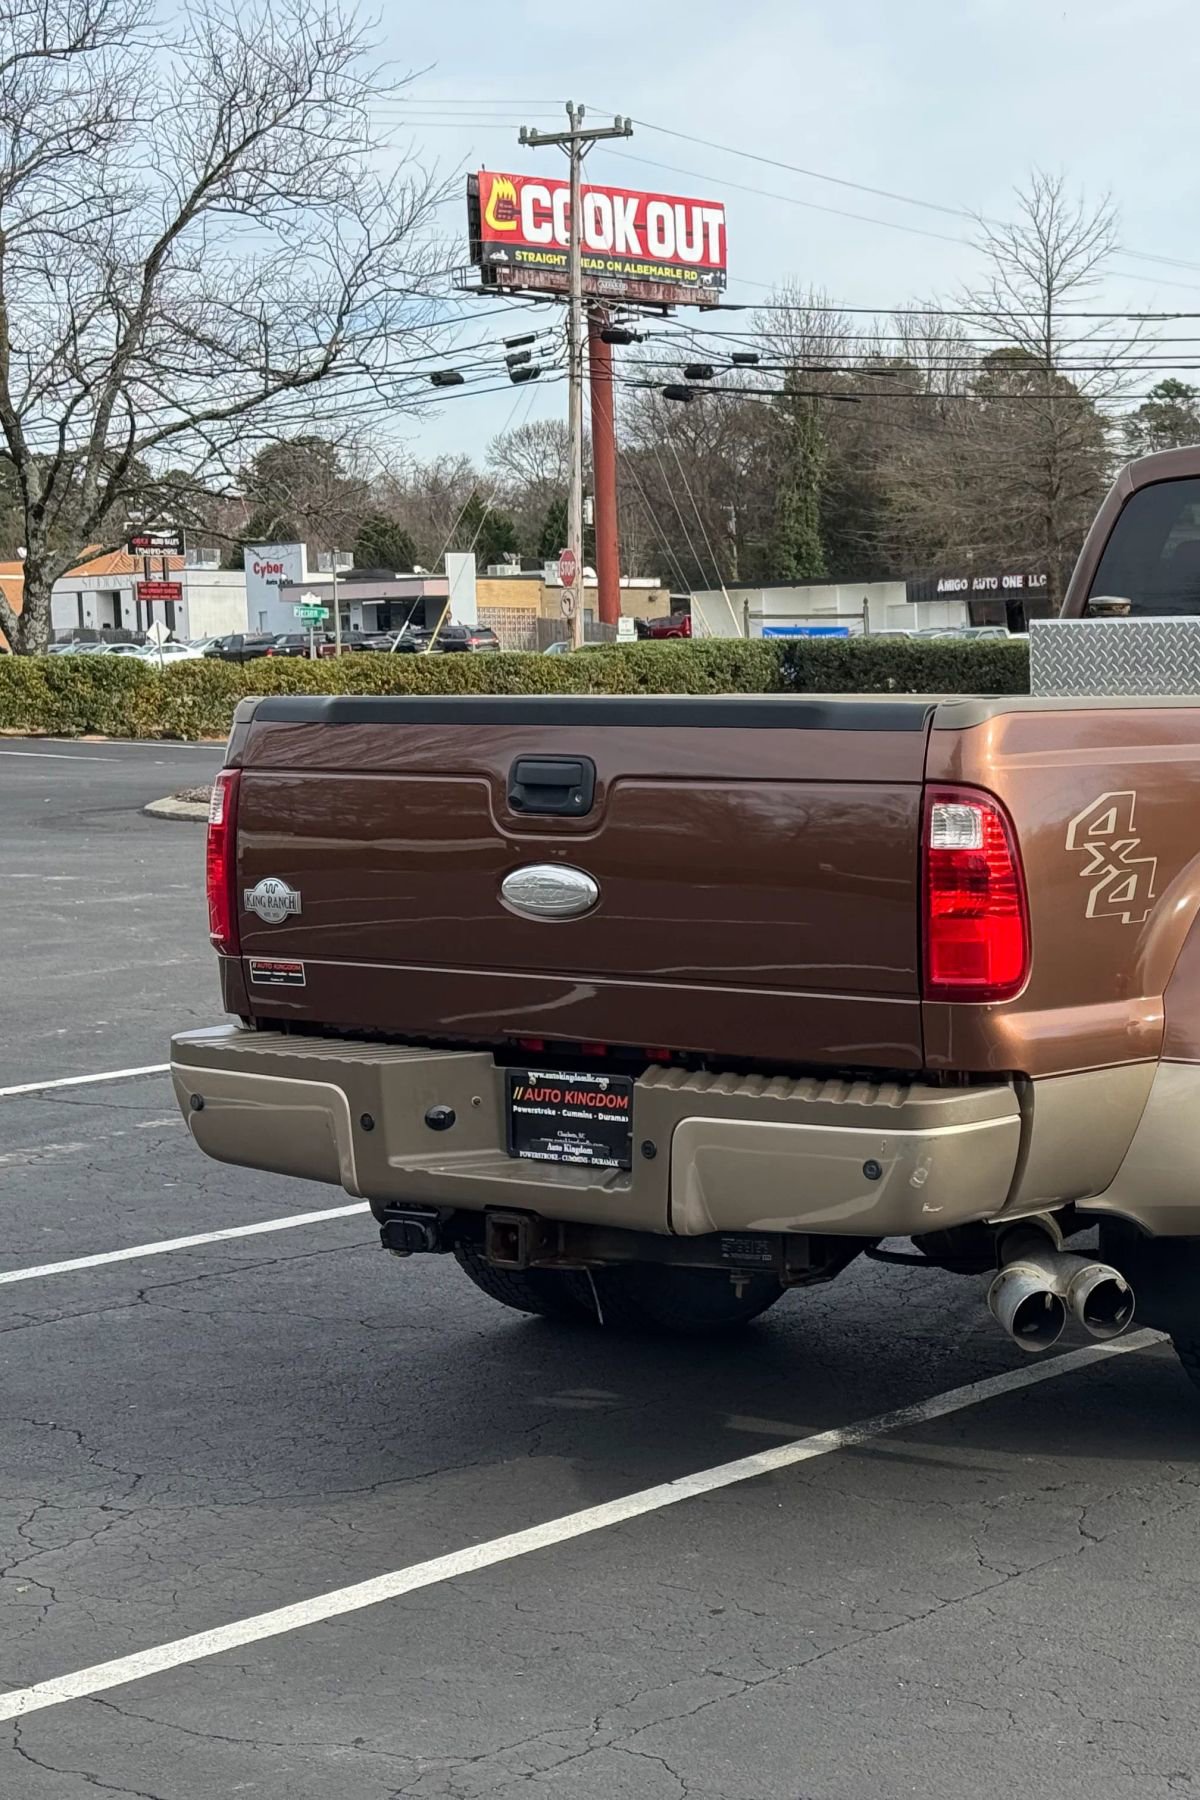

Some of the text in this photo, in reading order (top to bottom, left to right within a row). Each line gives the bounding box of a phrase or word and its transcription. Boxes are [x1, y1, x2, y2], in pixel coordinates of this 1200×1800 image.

[520, 184, 724, 264] COOK OUT
[515, 250, 698, 281] STRAIGHT EAD ON ALBEMARLE RD
[253, 561, 284, 578] Cyber
[561, 561, 576, 577] STOP
[937, 574, 1047, 592] AMIGO AUTO ONE LLC
[246, 893, 296, 909] KING RANCH
[524, 1088, 628, 1109] AUTO KINGDOM
[513, 1105, 556, 1116] Powerstroke
[562, 1109, 592, 1119] Cummins
[563, 1143, 593, 1155] Kingdom
